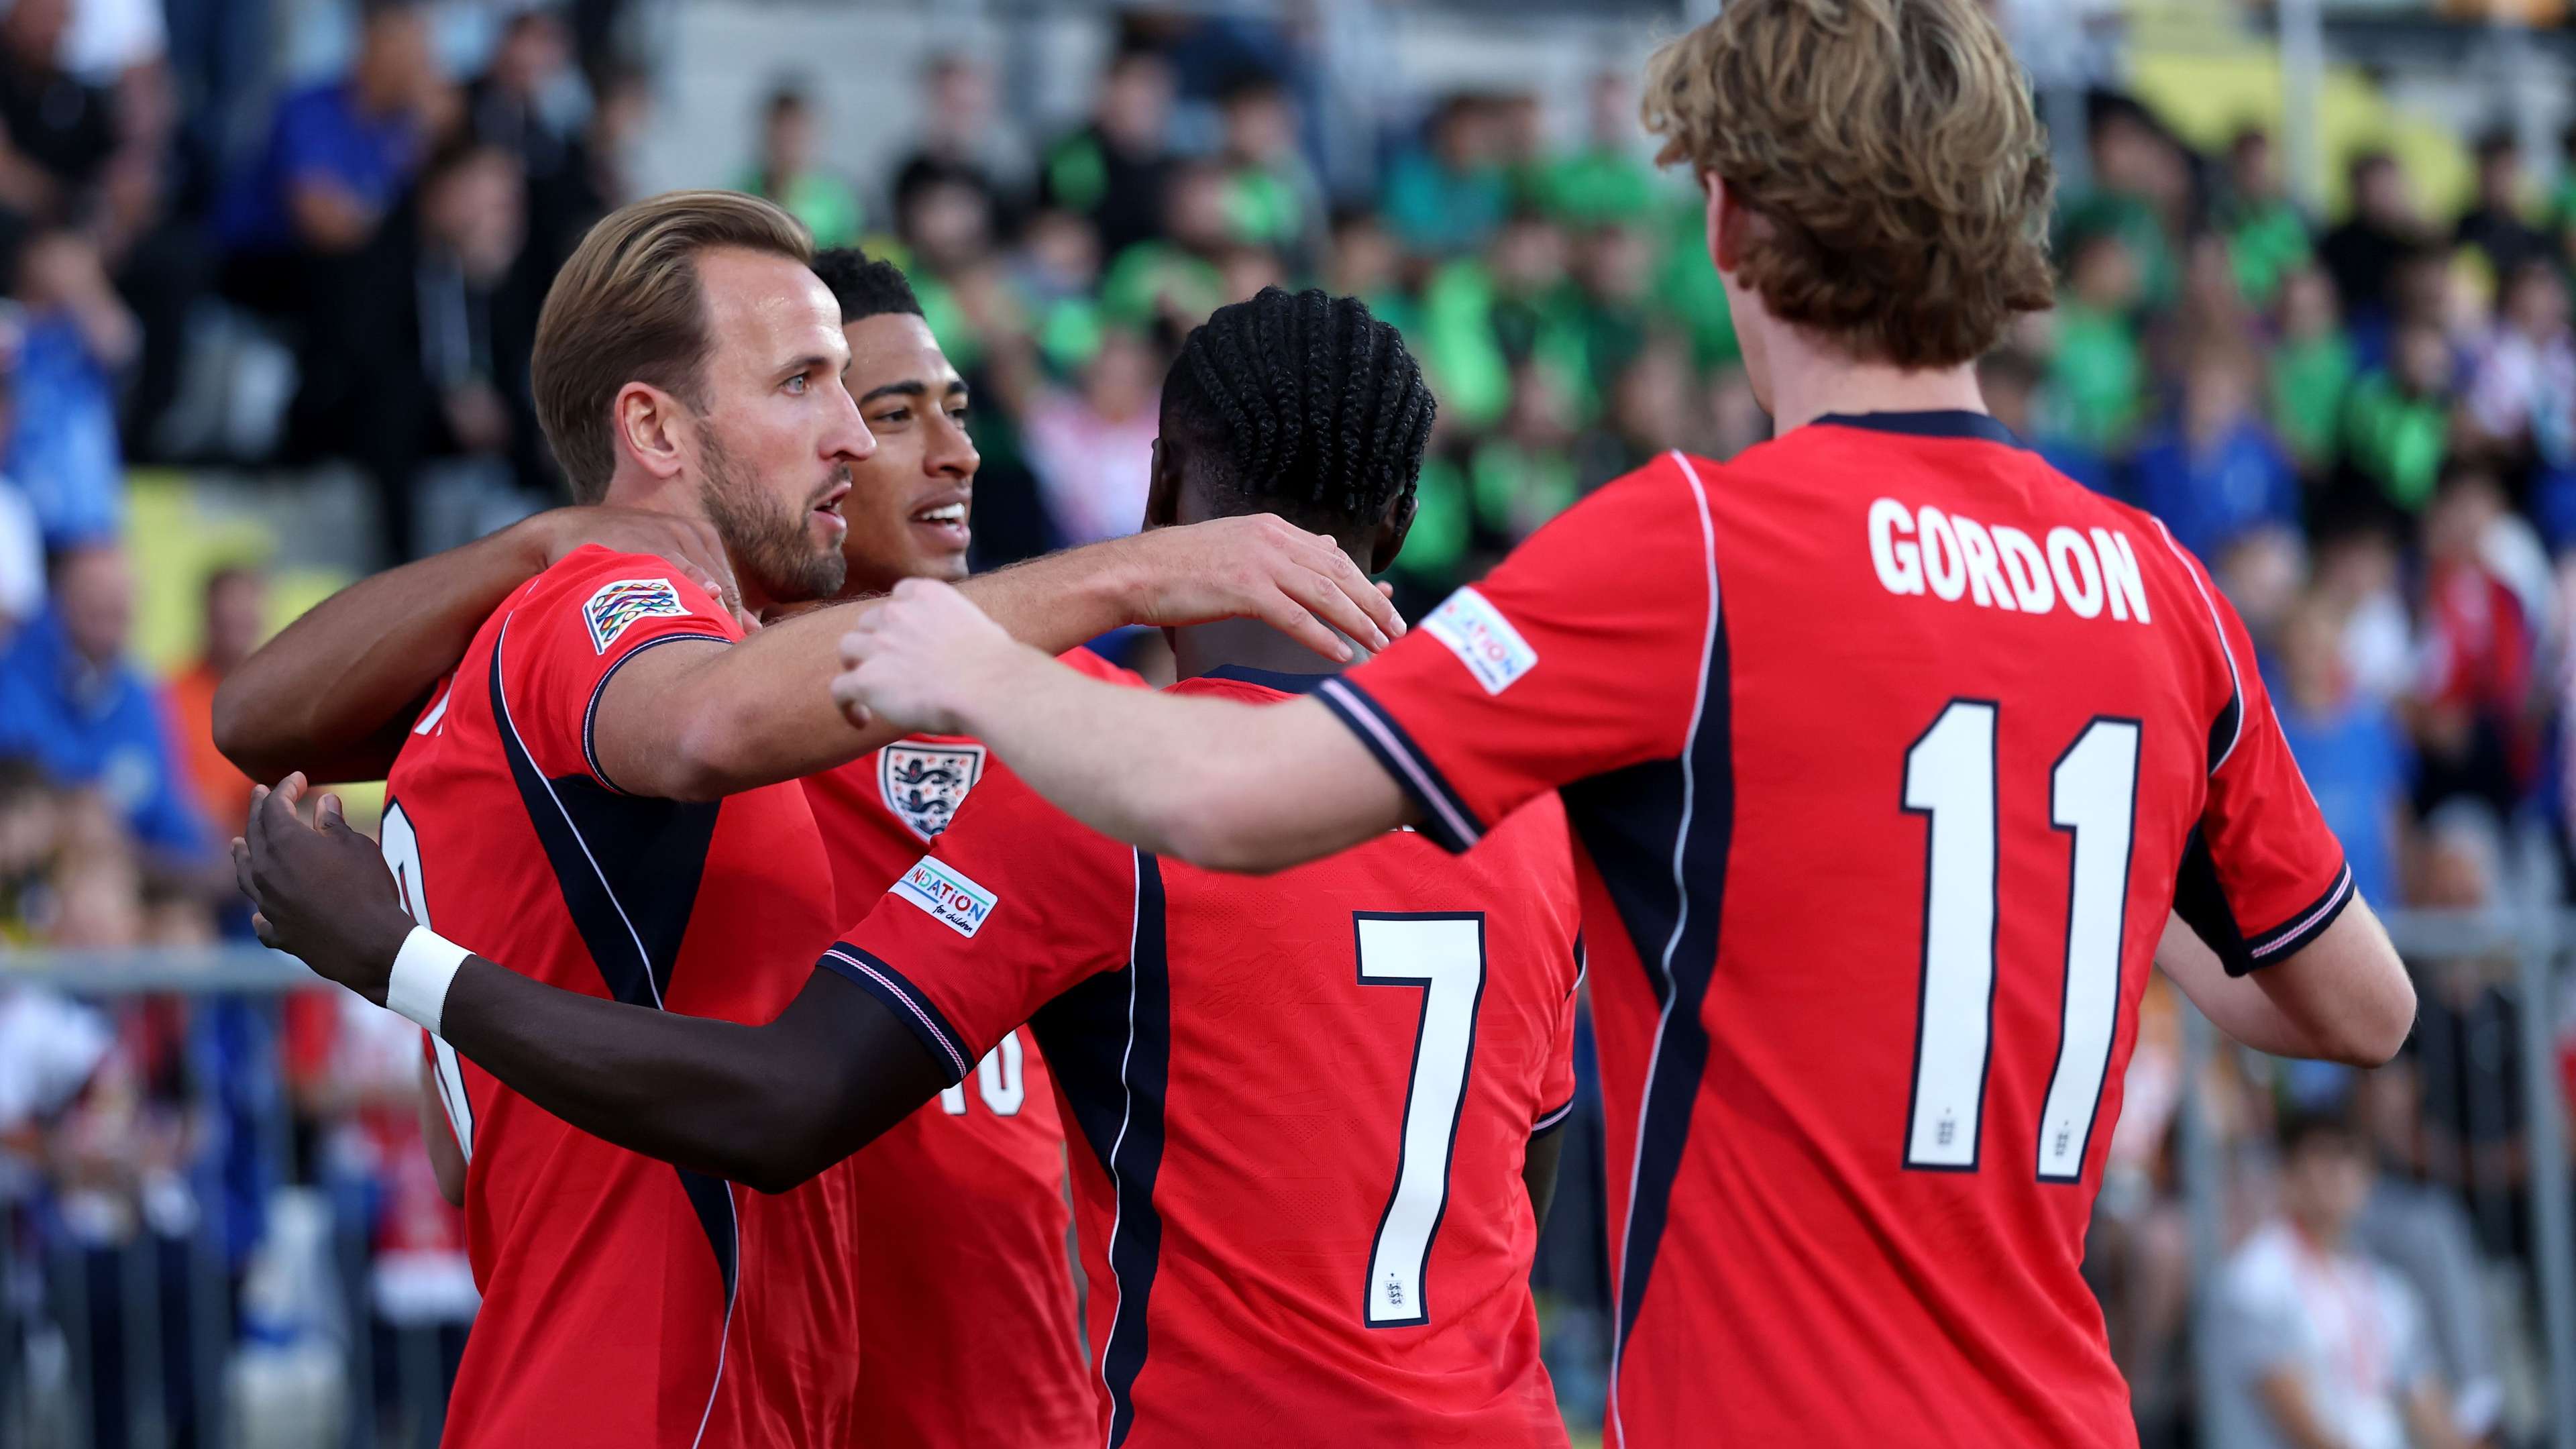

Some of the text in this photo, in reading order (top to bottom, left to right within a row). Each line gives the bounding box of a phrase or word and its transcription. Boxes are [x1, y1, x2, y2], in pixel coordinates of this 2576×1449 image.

[1868, 497, 2151, 624] GORDON
[932, 904, 973, 932] for children
[1899, 696, 2143, 1184] 11
[1352, 910, 1487, 1328] 7
